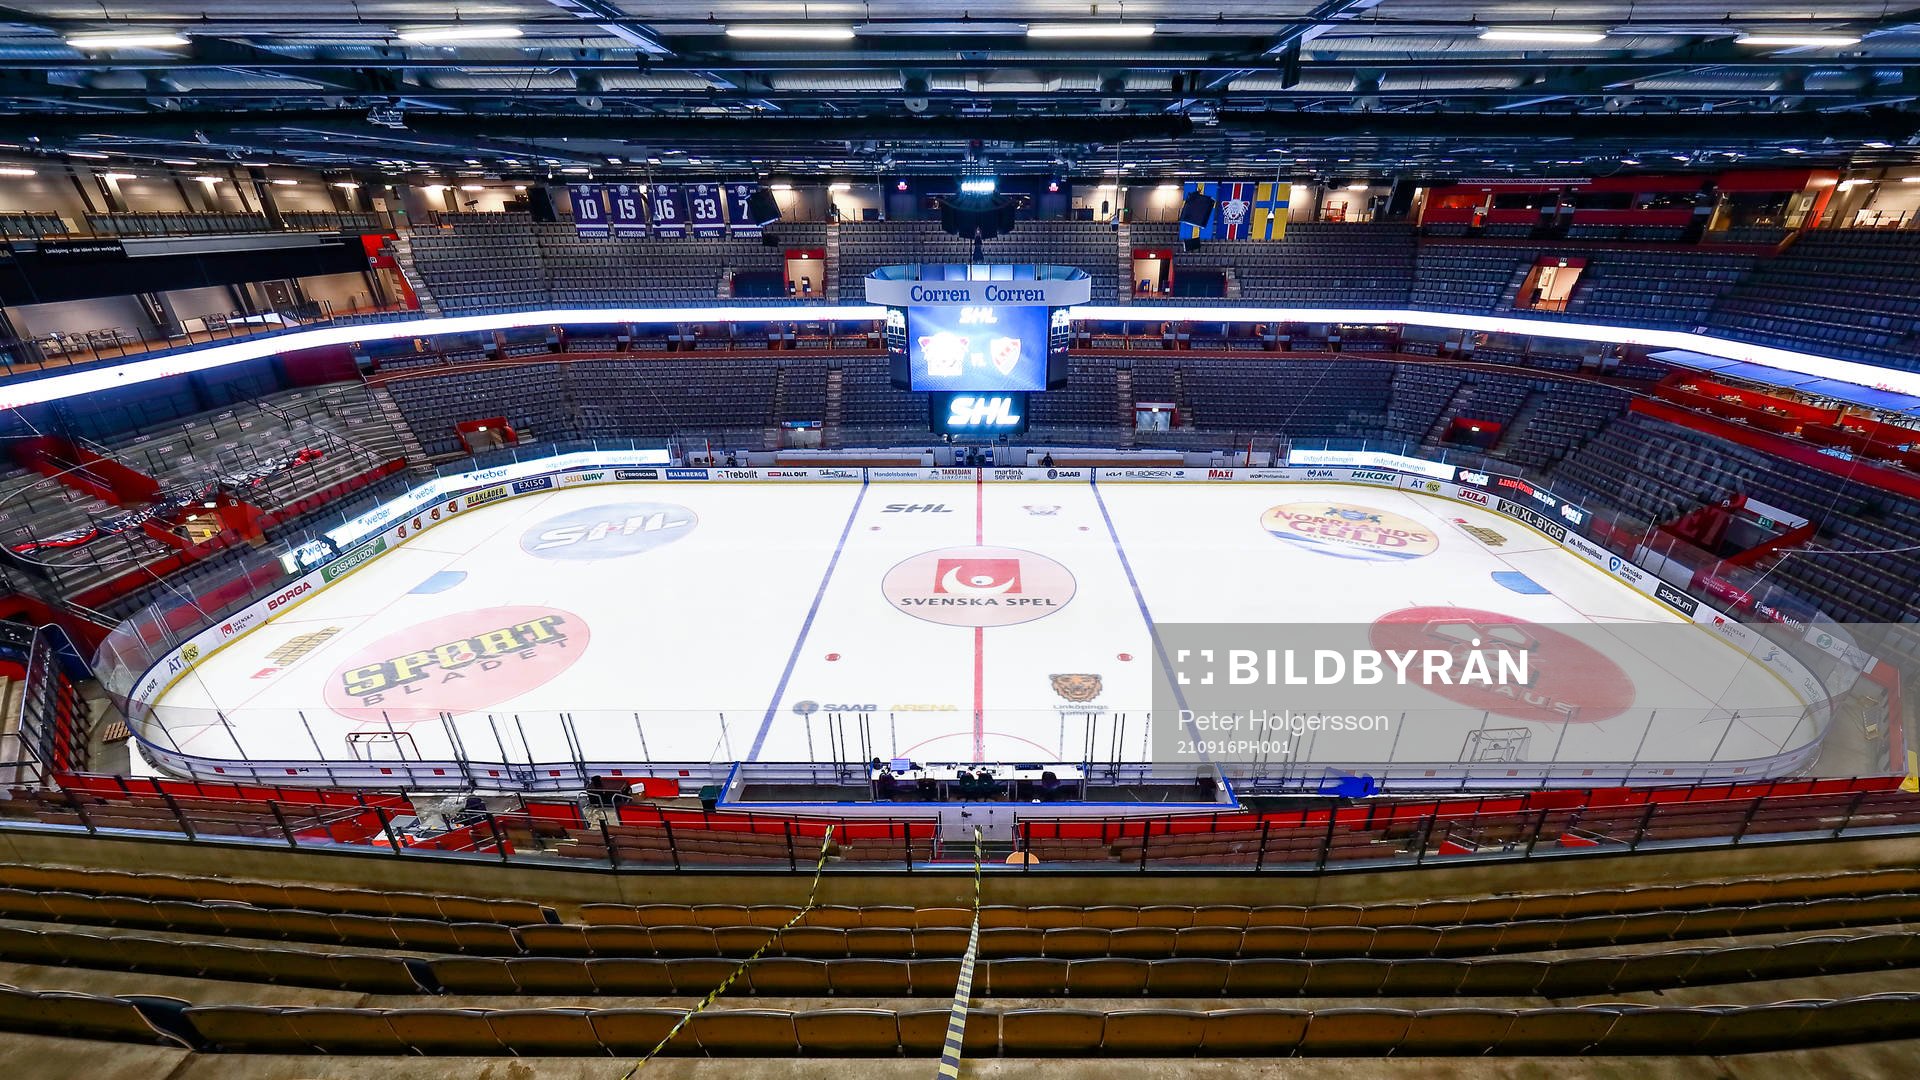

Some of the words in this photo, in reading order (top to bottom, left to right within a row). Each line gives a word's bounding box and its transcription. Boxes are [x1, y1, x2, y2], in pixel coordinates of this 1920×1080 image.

[578, 199, 599, 220] 10
[617, 199, 636, 220] 15
[693, 199, 716, 219] 33
[738, 199, 749, 220] 7
[910, 285, 971, 302] Corren
[985, 285, 1045, 302] Corren
[959, 308, 998, 324] SHL
[947, 397, 1020, 425] SHL
[472, 468, 508, 481] weber
[564, 472, 605, 482] SUBWAY
[667, 470, 707, 479] MALMBERGS
[725, 470, 758, 479] Trebolit
[1352, 470, 1396, 482] HiKOKI
[1410, 477, 1425, 489] ÄT
[415, 484, 437, 501] weber
[518, 478, 545, 490] EXISO
[1459, 489, 1487, 504] JULA
[880, 503, 954, 513] SHL
[364, 508, 391, 526] weber
[530, 512, 690, 552] SHL
[1273, 510, 1428, 543] NORRLANDS
[1288, 520, 1408, 547] GULD
[1518, 509, 1564, 543] XL-BYGG
[329, 547, 375, 577] CASHBUDDY
[1619, 570, 1636, 585] verken
[267, 582, 312, 610] BORGA
[901, 598, 999, 606] SVENSKA
[1006, 598, 1057, 606] SPEL
[1659, 588, 1692, 613] stadium
[231, 613, 254, 629] SVENSKA
[234, 623, 247, 633] SPEL
[1723, 624, 1747, 640] SVENSKA
[342, 614, 566, 698] SPORT
[167, 656, 183, 675] ÄT
[362, 637, 569, 707] BLADET
[823, 703, 877, 712] SAAB
[889, 703, 958, 712] ARENA
